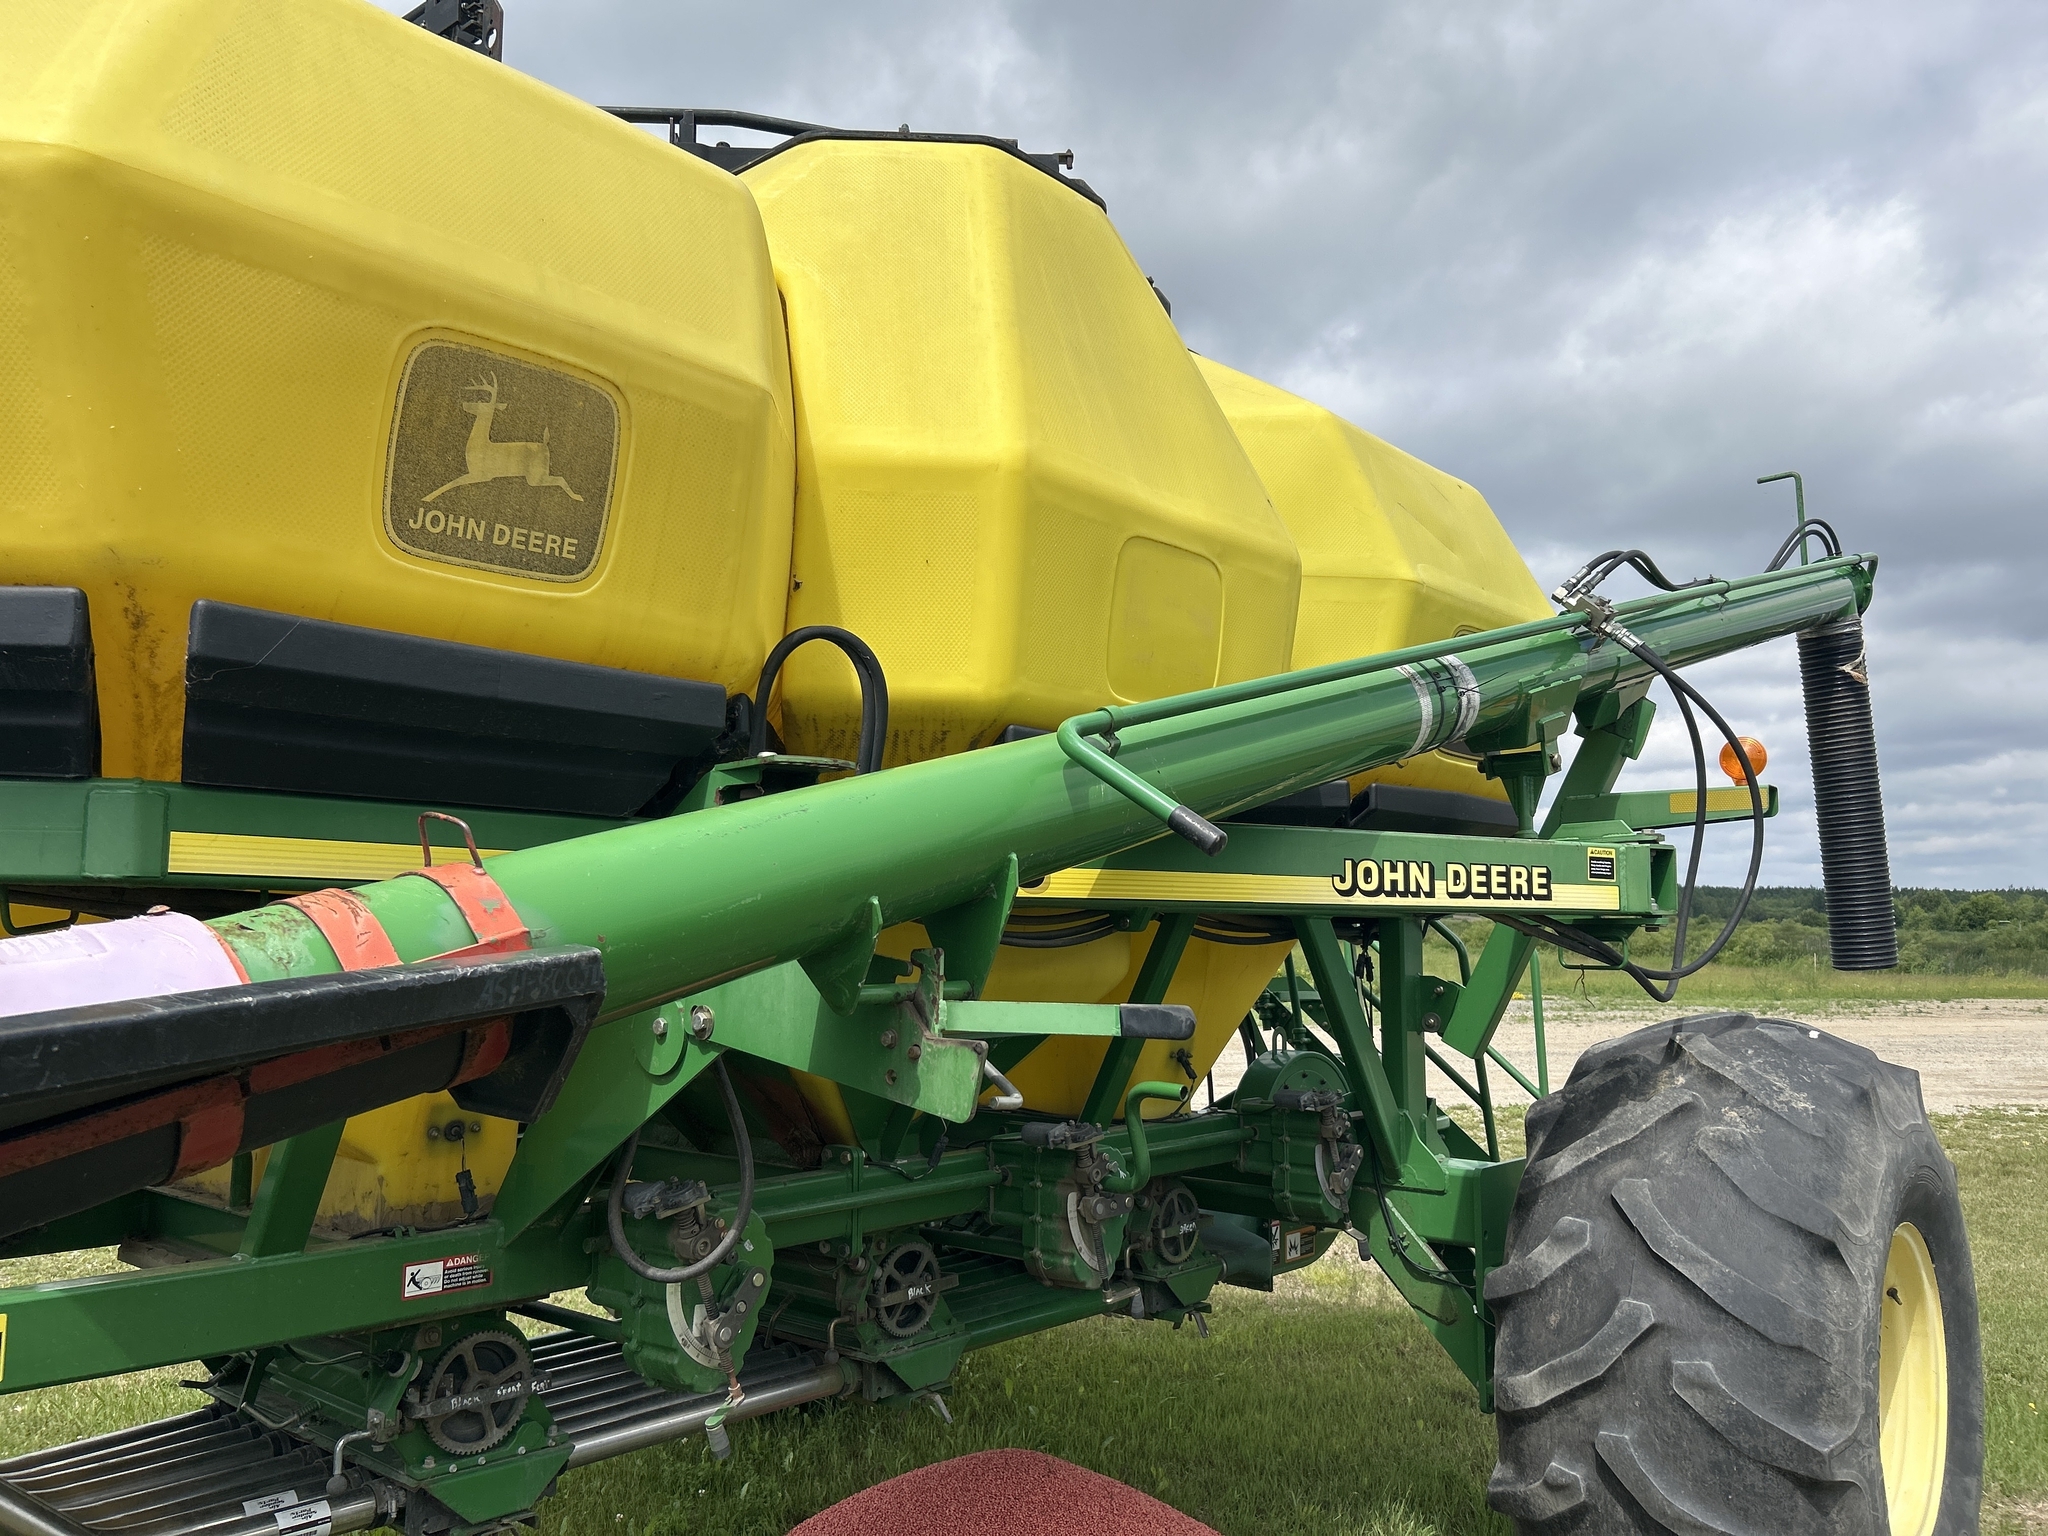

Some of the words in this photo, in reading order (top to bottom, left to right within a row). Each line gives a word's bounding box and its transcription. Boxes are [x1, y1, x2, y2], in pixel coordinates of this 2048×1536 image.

[408, 507, 486, 542] JOHN
[492, 524, 579, 560] DEERE
[1332, 858, 1434, 898] JOHN
[1446, 861, 1552, 901] DEERE
[454, 1253, 490, 1266] DANGER
